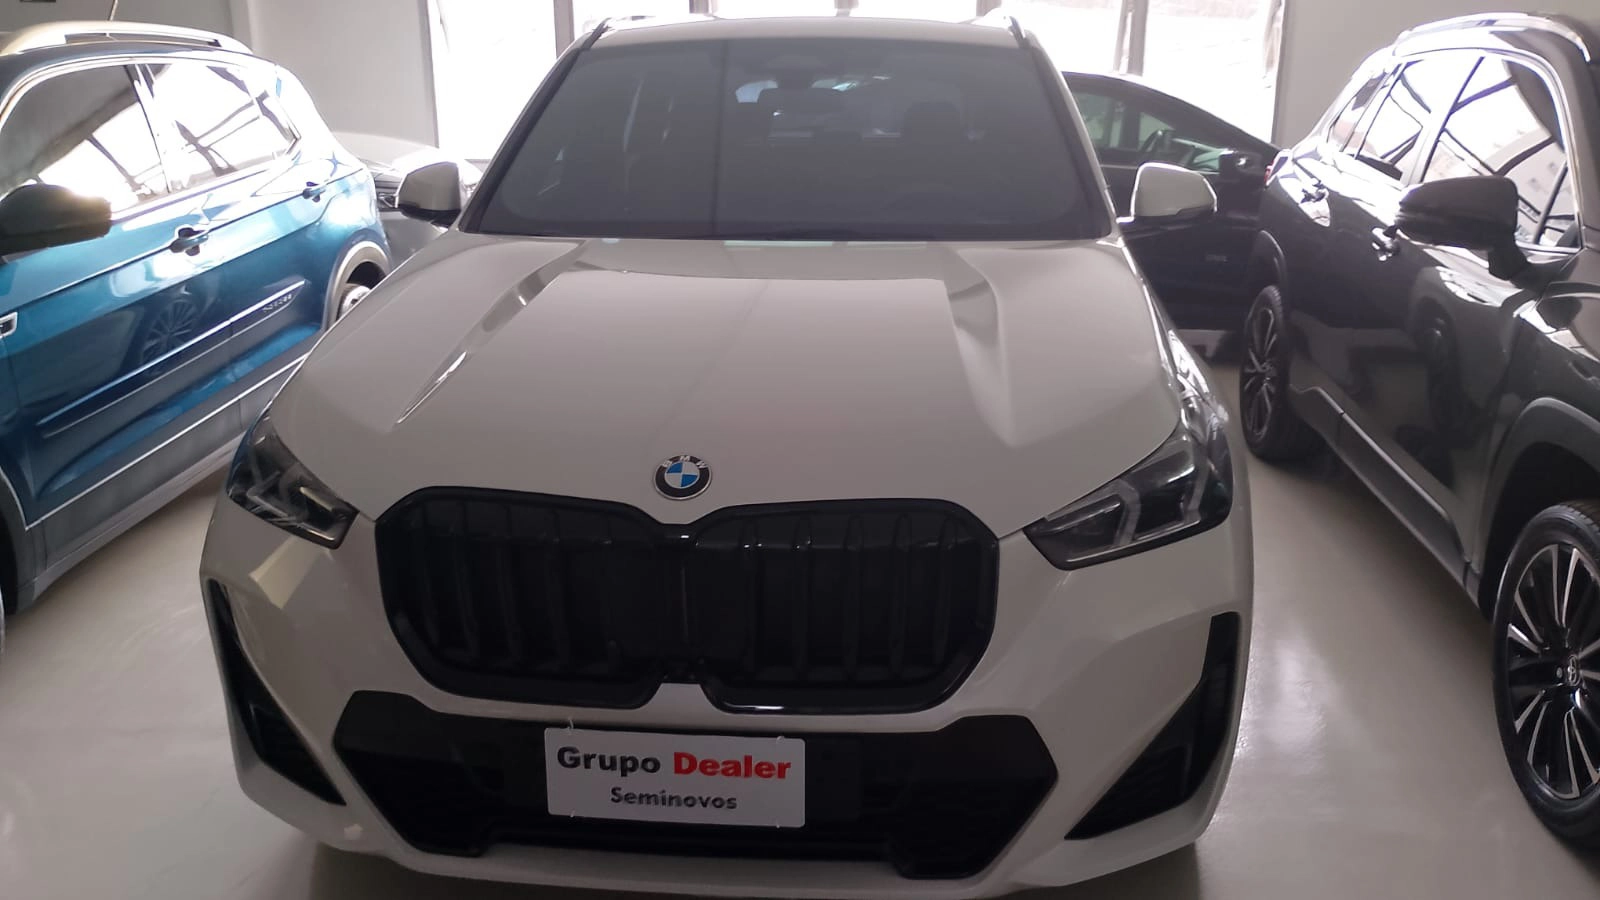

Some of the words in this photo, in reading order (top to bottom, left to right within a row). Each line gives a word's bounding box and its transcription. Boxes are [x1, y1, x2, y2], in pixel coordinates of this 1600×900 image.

[662, 455, 706, 469] BMW
[557, 746, 661, 777] Grupo
[673, 752, 792, 779] Dealer
[610, 787, 738, 809] Seminovos
